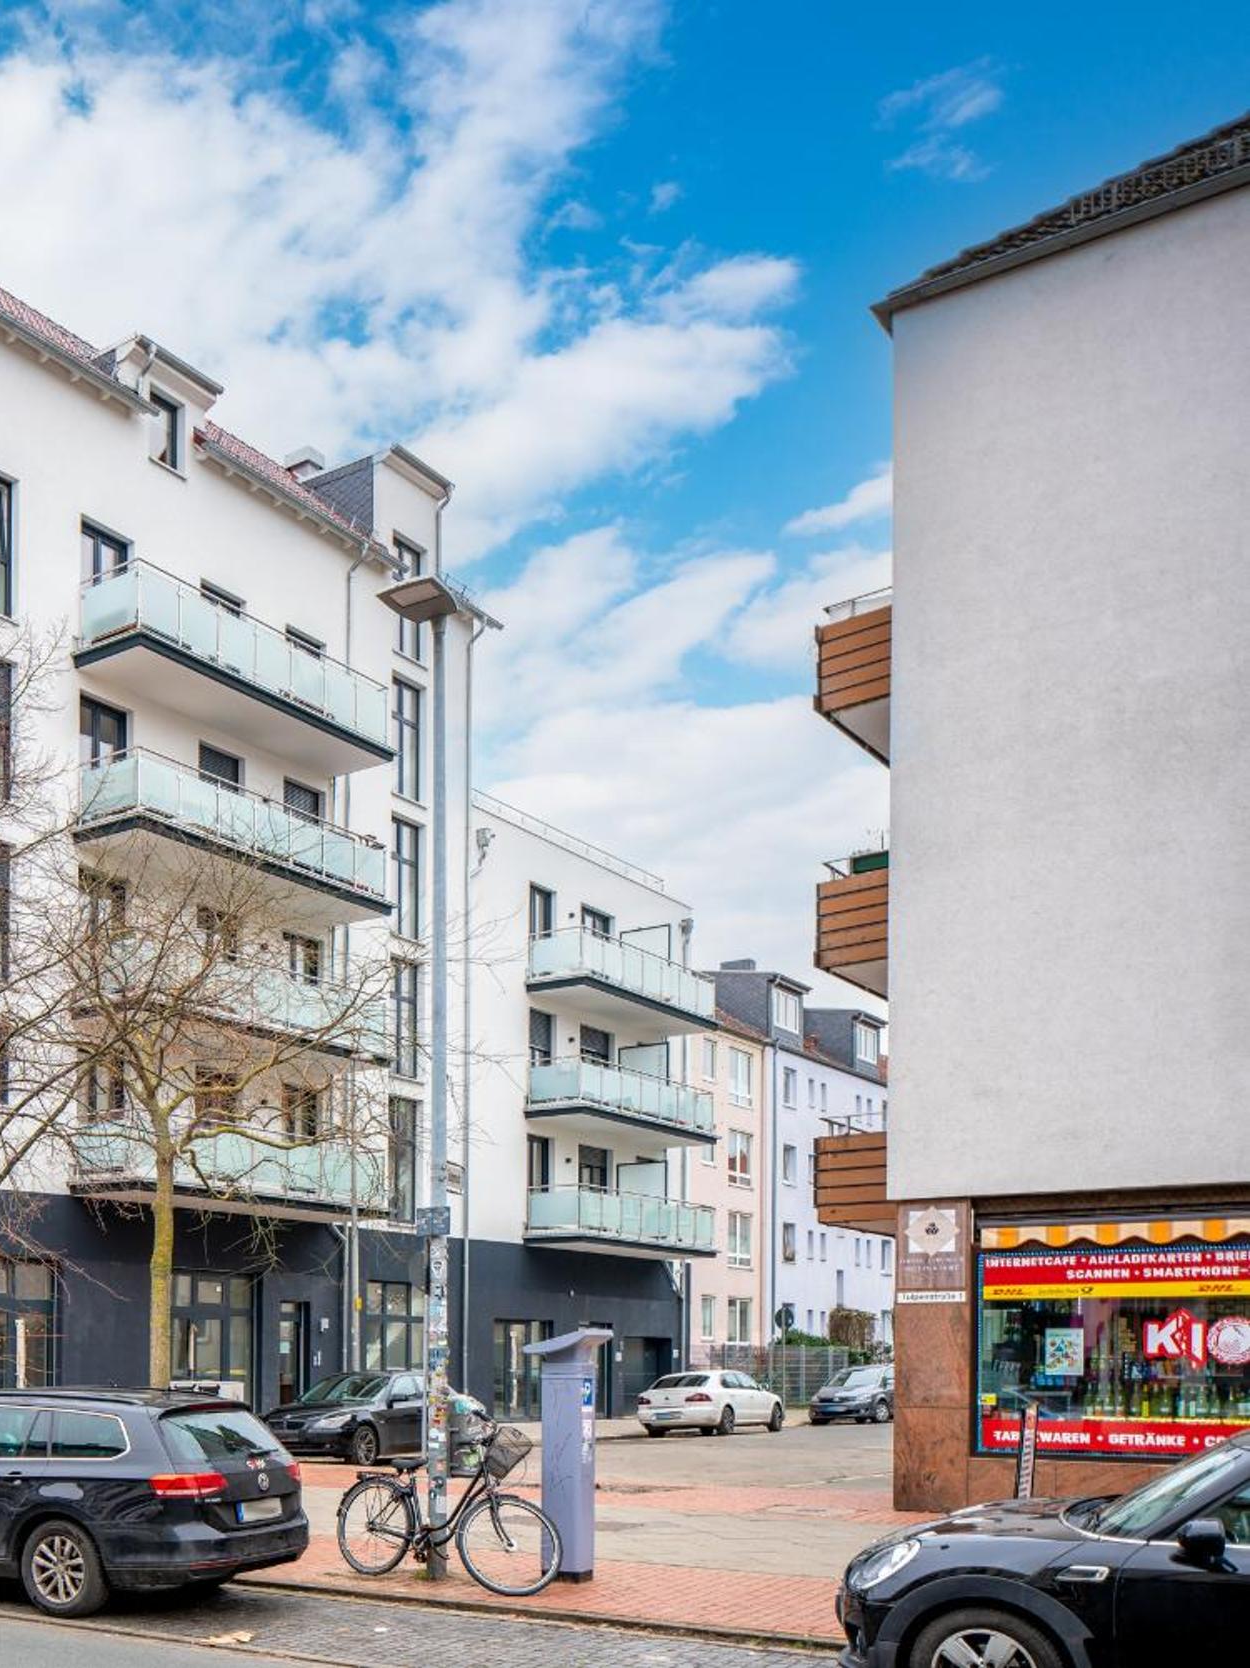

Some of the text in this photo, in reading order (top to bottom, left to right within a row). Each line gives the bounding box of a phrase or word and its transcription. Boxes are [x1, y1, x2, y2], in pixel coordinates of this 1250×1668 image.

[985, 1255, 1077, 1268] INTERNETCAFE
[1088, 1251, 1203, 1265] AUFLADEKARTEN
[1065, 1267, 1130, 1280] SCANNEN
[993, 1430, 1091, 1444] TABWAREN
[1108, 1432, 1186, 1447] GETRÄNKE
